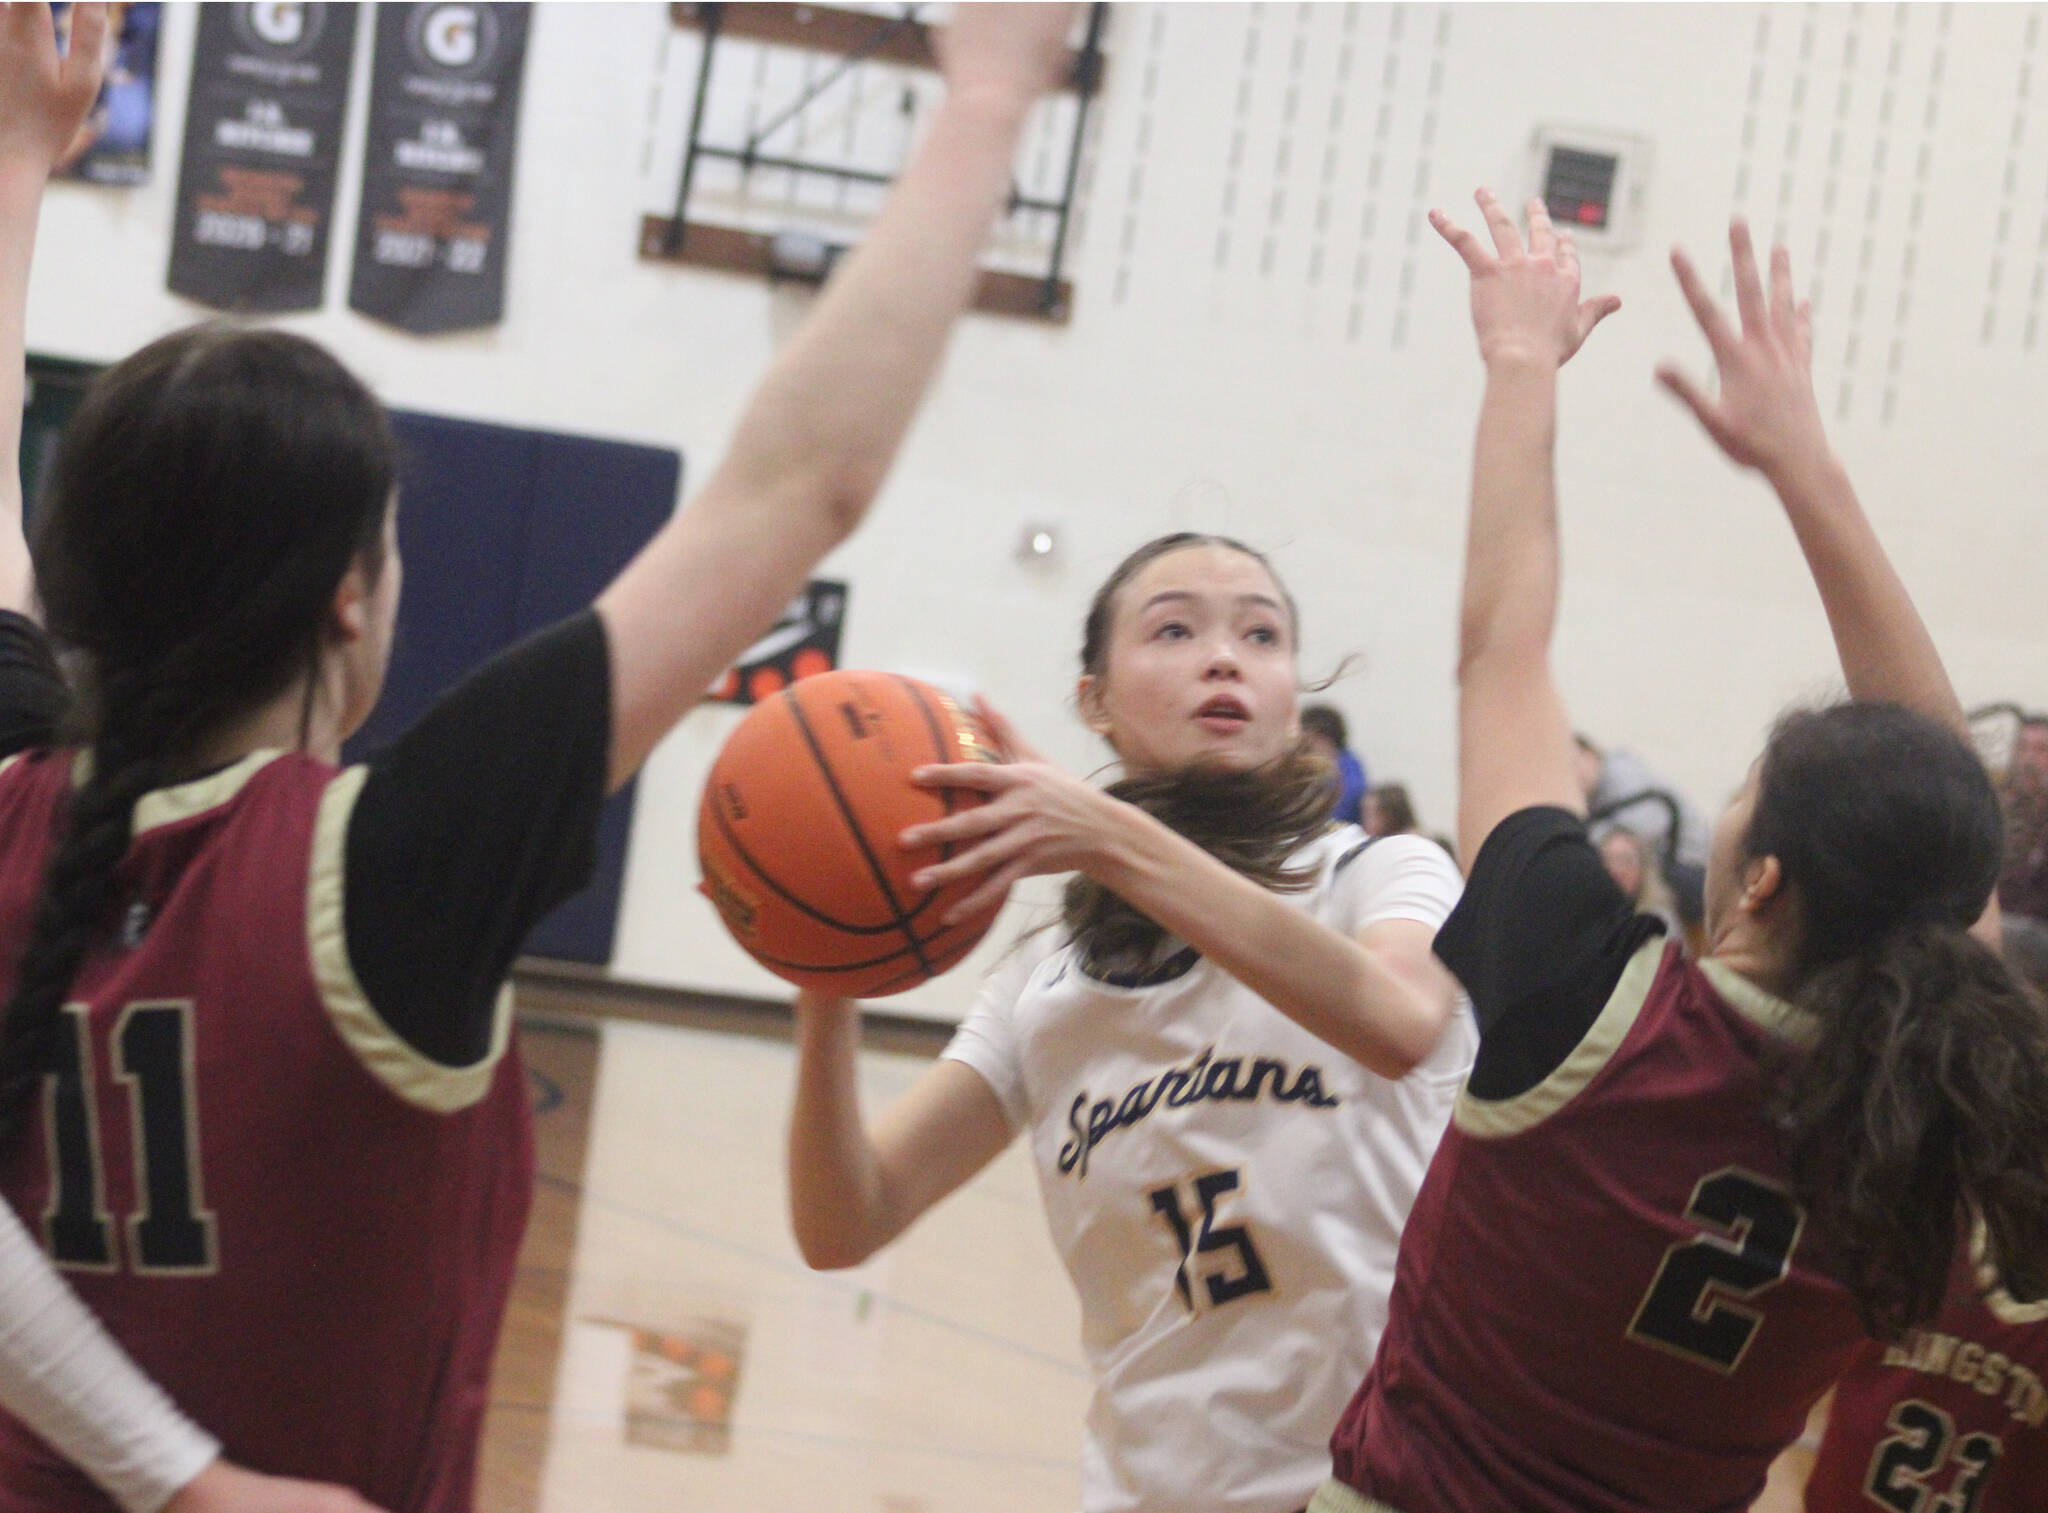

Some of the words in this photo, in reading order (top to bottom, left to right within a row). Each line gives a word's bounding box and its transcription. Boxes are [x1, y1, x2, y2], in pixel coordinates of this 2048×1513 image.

[41, 997, 220, 1277] 11
[1058, 1045, 1341, 1180] Spartans
[1147, 1166, 1273, 1312] 15
[1626, 1164, 1807, 1376] 2
[1863, 1398, 2005, 1513] 23
